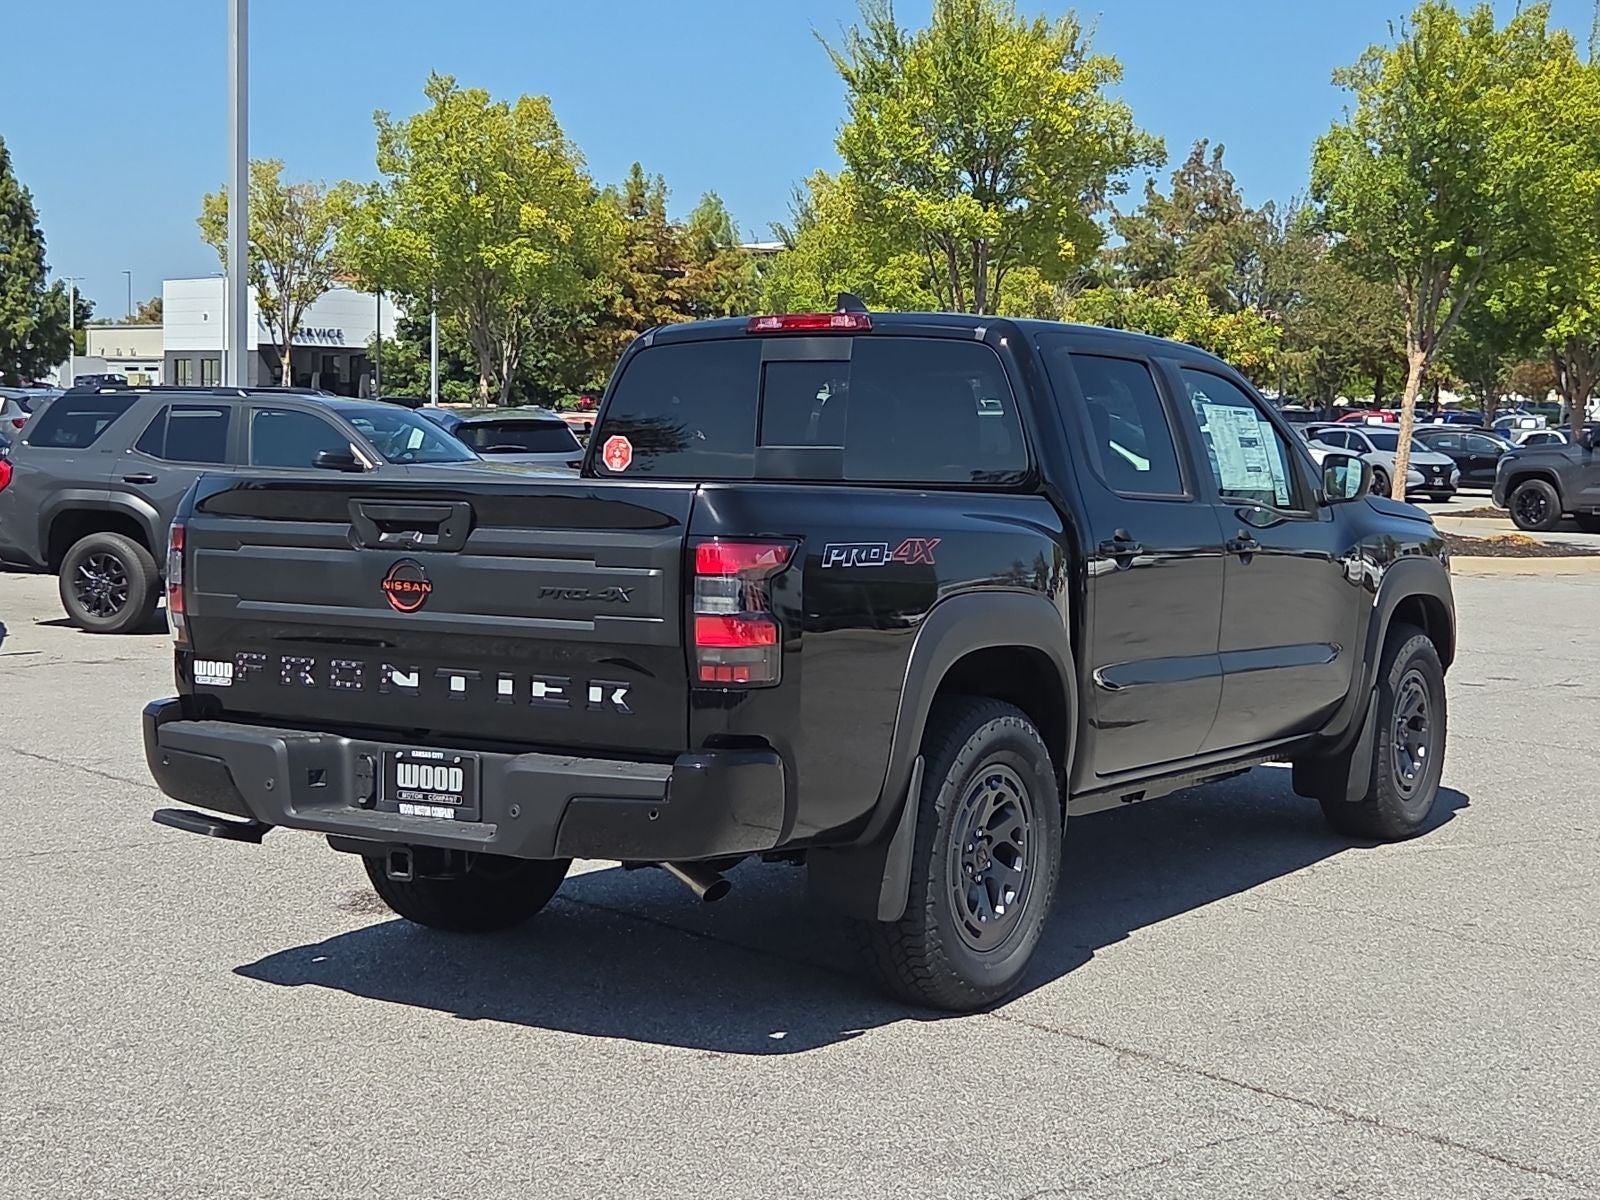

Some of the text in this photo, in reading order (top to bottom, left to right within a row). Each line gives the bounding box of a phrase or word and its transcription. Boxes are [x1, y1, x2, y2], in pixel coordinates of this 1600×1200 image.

[296, 327, 344, 339] ERVICE
[383, 581, 432, 592] NISSAN
[193, 659, 233, 678] WOOD
[234, 651, 635, 714] FRONTIER
[397, 763, 463, 792] WOOD
[428, 794, 457, 802] COMPANY
